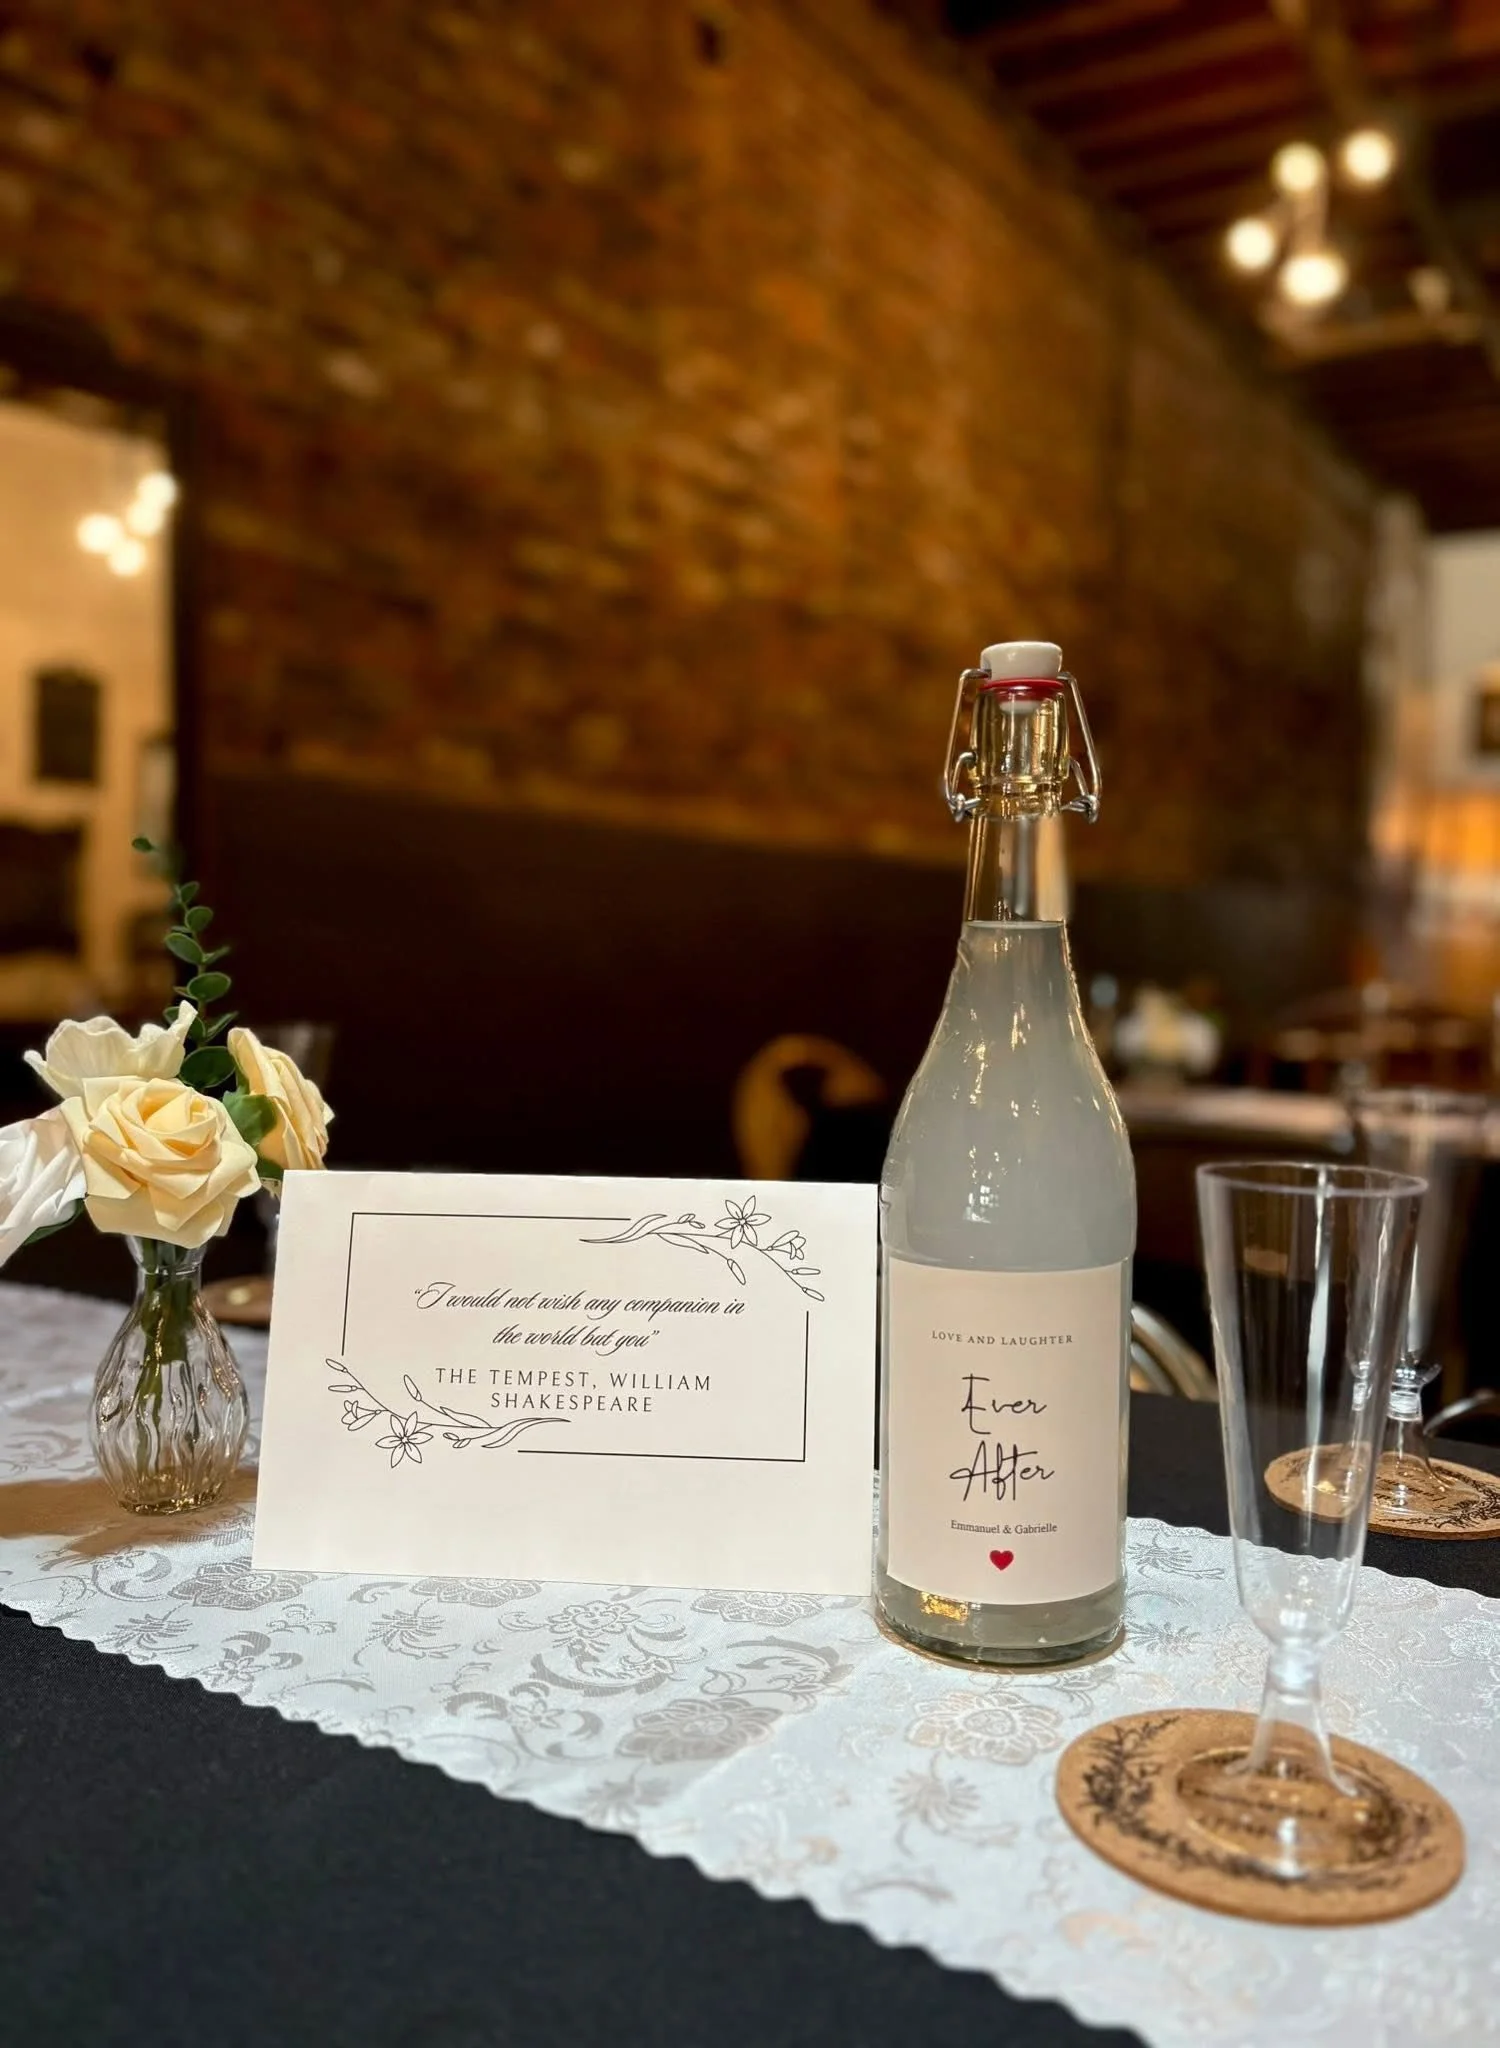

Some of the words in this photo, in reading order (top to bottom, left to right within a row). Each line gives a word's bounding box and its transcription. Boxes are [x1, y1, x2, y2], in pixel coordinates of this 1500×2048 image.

[446, 1288, 511, 1308] would
[504, 1292, 541, 1310] not
[538, 1290, 586, 1311] wish
[584, 1297, 621, 1320] any
[624, 1298, 720, 1322] companion
[724, 1298, 746, 1315] in
[492, 1324, 522, 1345] the
[525, 1325, 582, 1346] world
[580, 1326, 617, 1347] but
[595, 1330, 660, 1356] you”
[932, 1330, 962, 1343] LOVE
[967, 1335, 996, 1345] AND
[1001, 1334, 1074, 1346] LAUGHTER
[435, 1368, 477, 1384] THE
[489, 1370, 597, 1390] TEMPEST,
[610, 1373, 711, 1391] WILLIAM
[491, 1392, 653, 1412] SHAKESPEARE
[961, 1373, 1047, 1434] Ever
[950, 1440, 1055, 1501] After
[950, 1520, 1000, 1534] Emmanuel
[1003, 1523, 1012, 1534] &
[1014, 1522, 1058, 1534] Gabrielle
